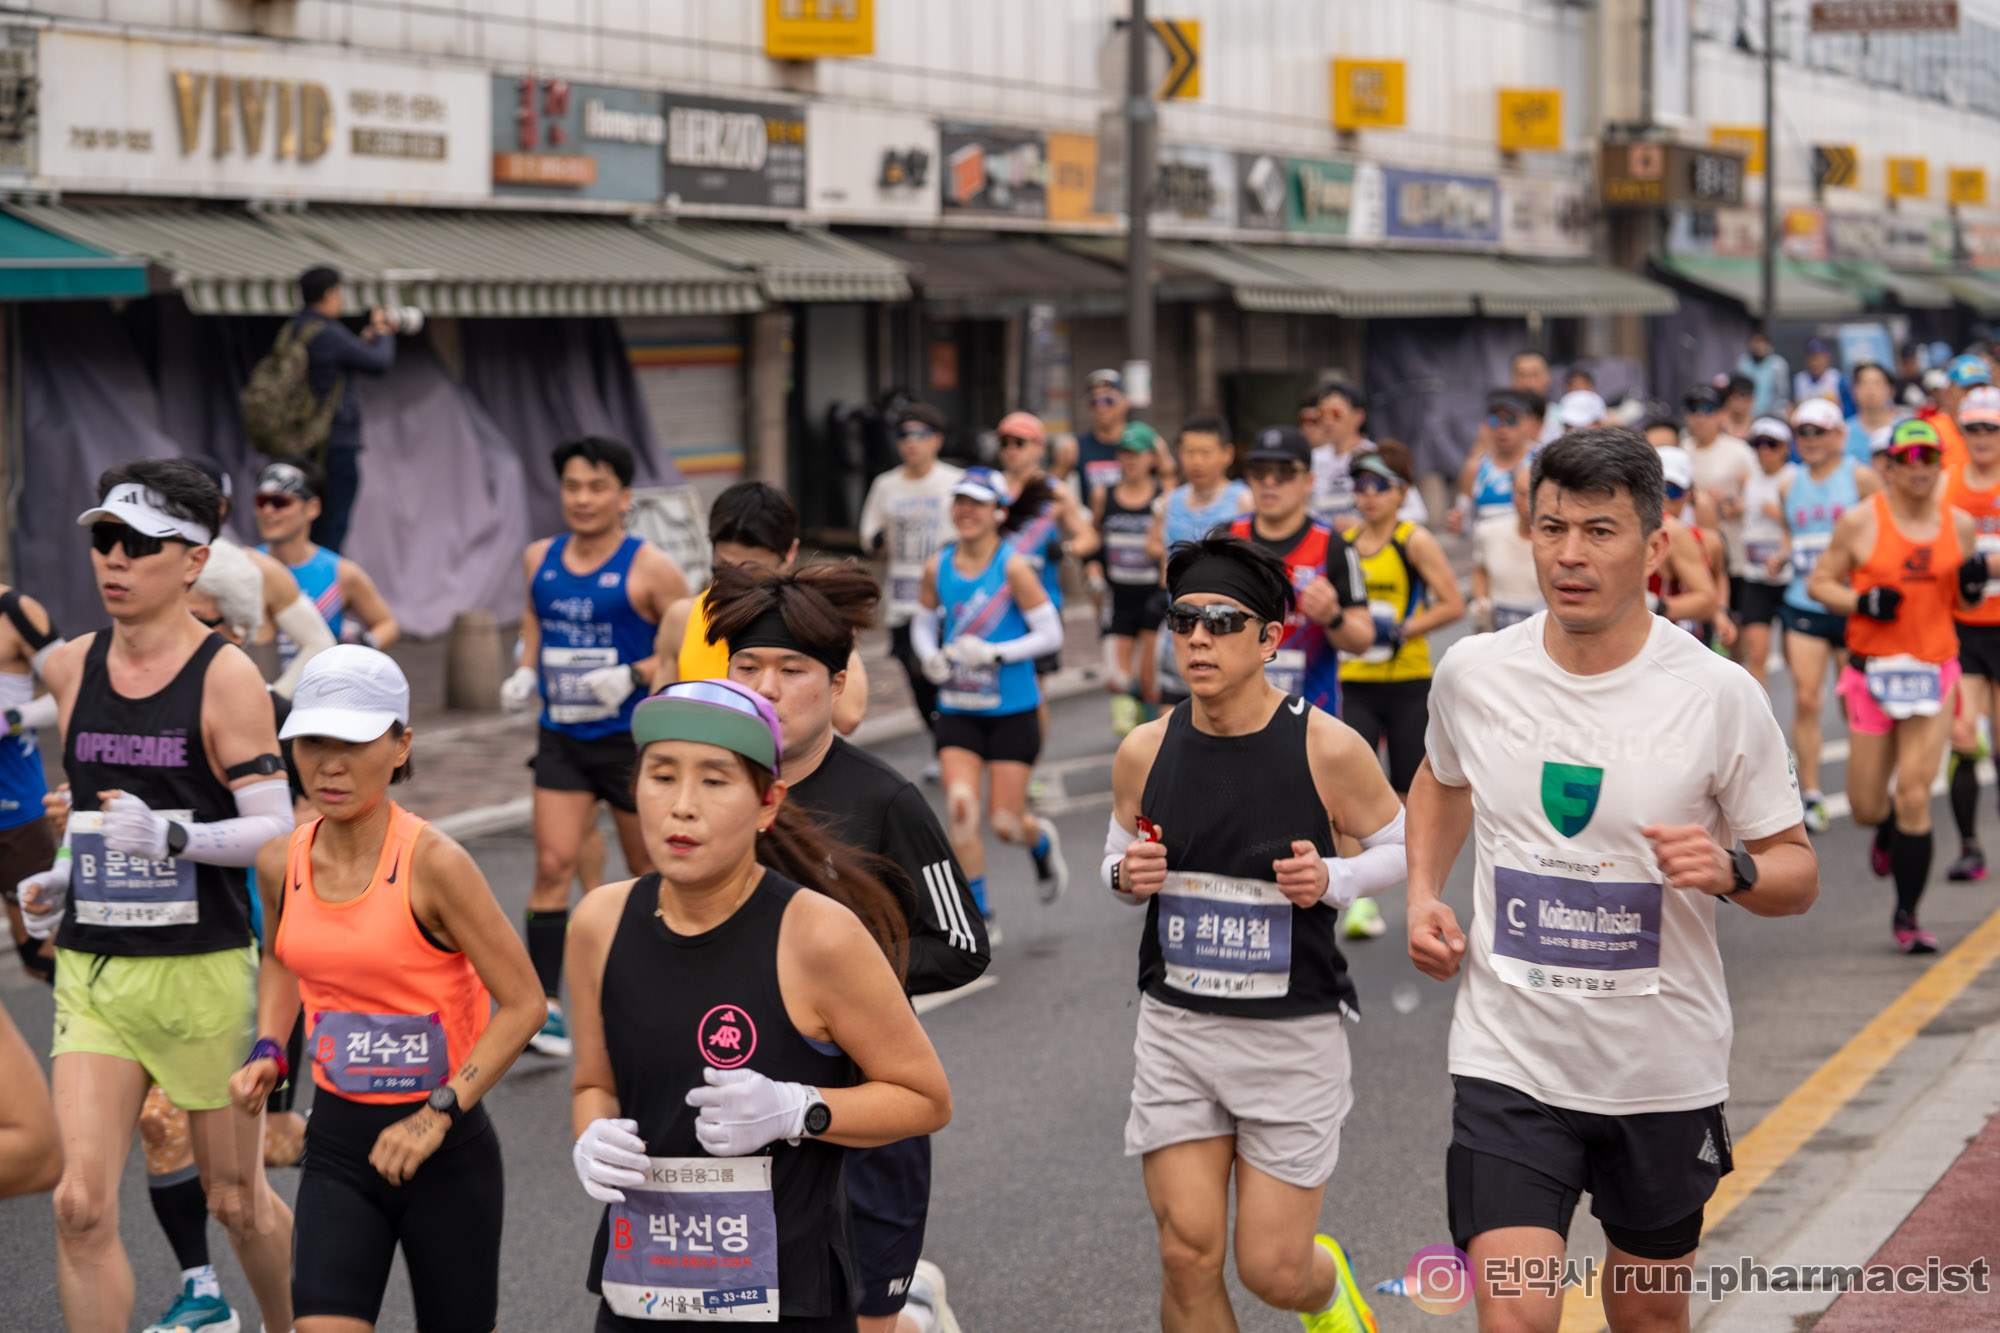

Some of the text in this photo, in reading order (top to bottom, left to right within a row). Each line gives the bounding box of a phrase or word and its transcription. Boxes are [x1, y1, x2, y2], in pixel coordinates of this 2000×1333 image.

[171, 70, 334, 163] VIVID
[668, 106, 769, 171] HERZO
[75, 732, 188, 767] OPENCARE
[1540, 857, 1600, 876] samyang
[1168, 915, 1185, 942] B
[1506, 898, 1527, 929] C
[1597, 905, 1641, 935] Ruslan
[1552, 974, 1616, 991] 동아일보
[317, 1035, 336, 1063] B
[346, 1031, 430, 1064] 전수진
[614, 1217, 633, 1250] B
[649, 1213, 749, 1253] 박선영
[661, 1294, 733, 1314] 서울특
[723, 1290, 758, 1302] 33-422
